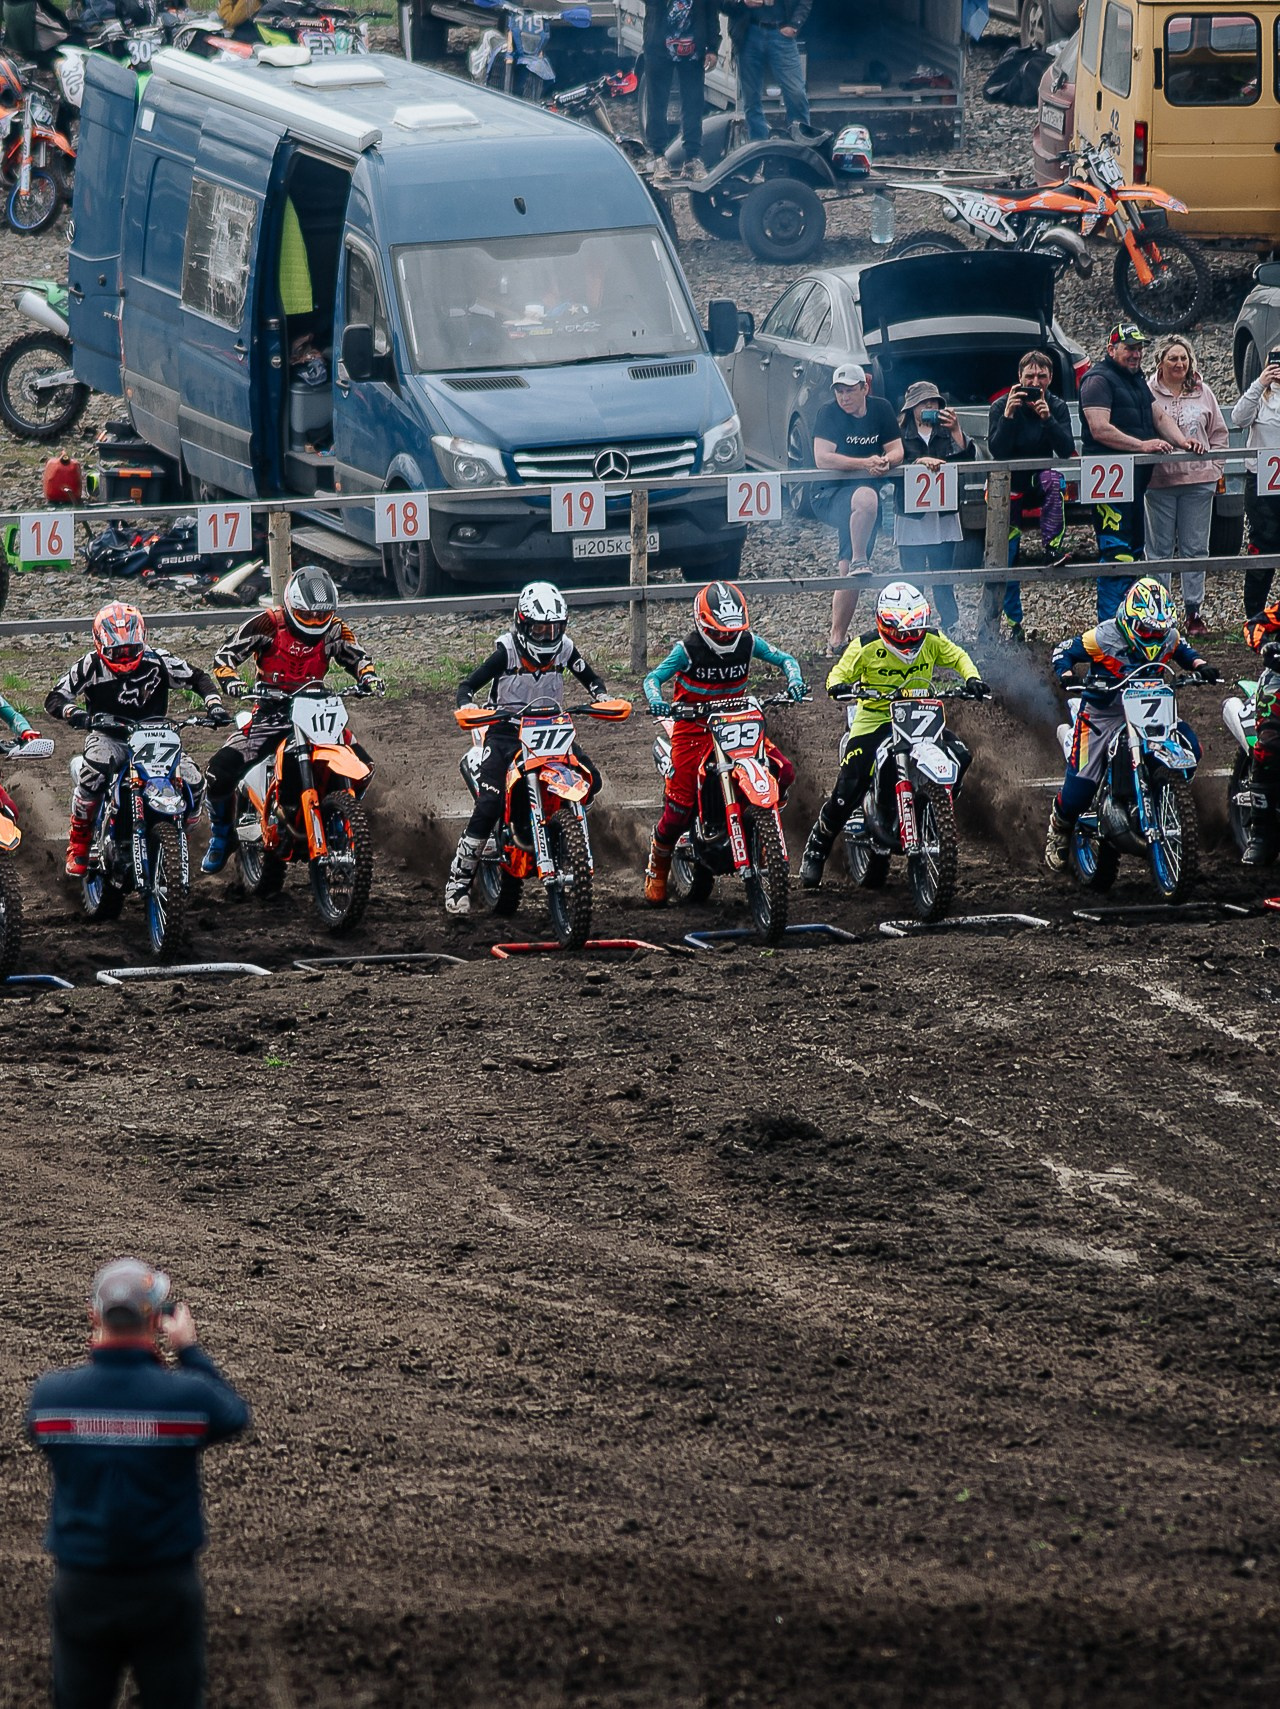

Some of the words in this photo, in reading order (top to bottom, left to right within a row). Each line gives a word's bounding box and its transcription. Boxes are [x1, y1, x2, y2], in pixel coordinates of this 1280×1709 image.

[915, 472, 945, 508] 21
[1090, 464, 1124, 499] 22
[1267, 456, 1280, 491] 2
[562, 491, 594, 527] 19
[738, 481, 771, 517] 20
[208, 512, 240, 548] 17
[386, 501, 419, 537] 18
[31, 520, 63, 556] 16
[696, 663, 748, 680] SEVEN
[311, 712, 338, 734] 117
[910, 709, 937, 737] 7
[1141, 698, 1162, 719] 7
[132, 742, 181, 765] 47
[530, 728, 574, 751] 317
[720, 721, 760, 751] 33
